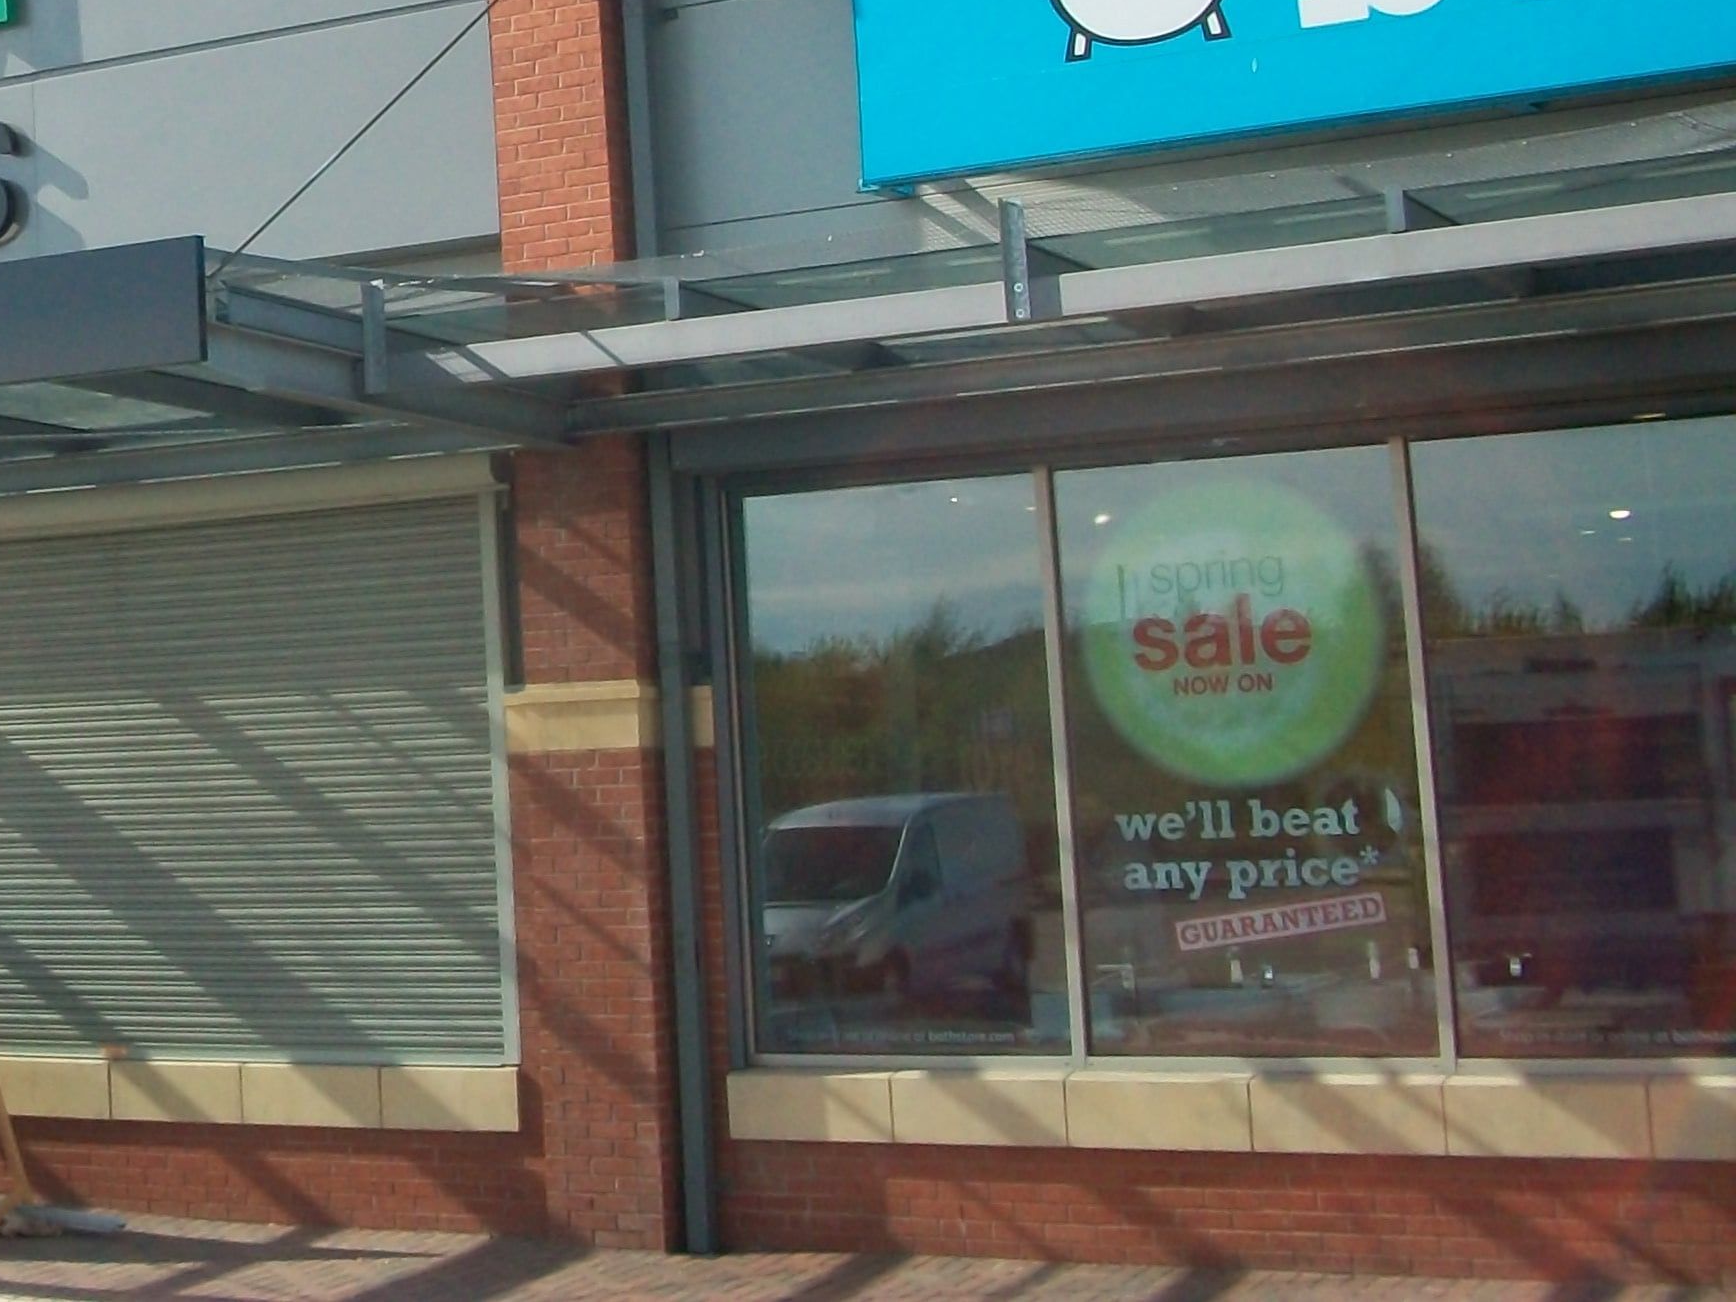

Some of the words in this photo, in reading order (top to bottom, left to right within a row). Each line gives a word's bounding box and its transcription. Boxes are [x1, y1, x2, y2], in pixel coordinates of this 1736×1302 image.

[1150, 555, 1284, 603] spring
[1133, 592, 1312, 671] sale
[1173, 675, 1230, 696] NOW
[1237, 672, 1273, 693] ON
[1114, 798, 1235, 842] we'll
[1247, 797, 1360, 838] beat
[1123, 859, 1212, 901] any
[1179, 896, 1382, 945] GUARANTEED
